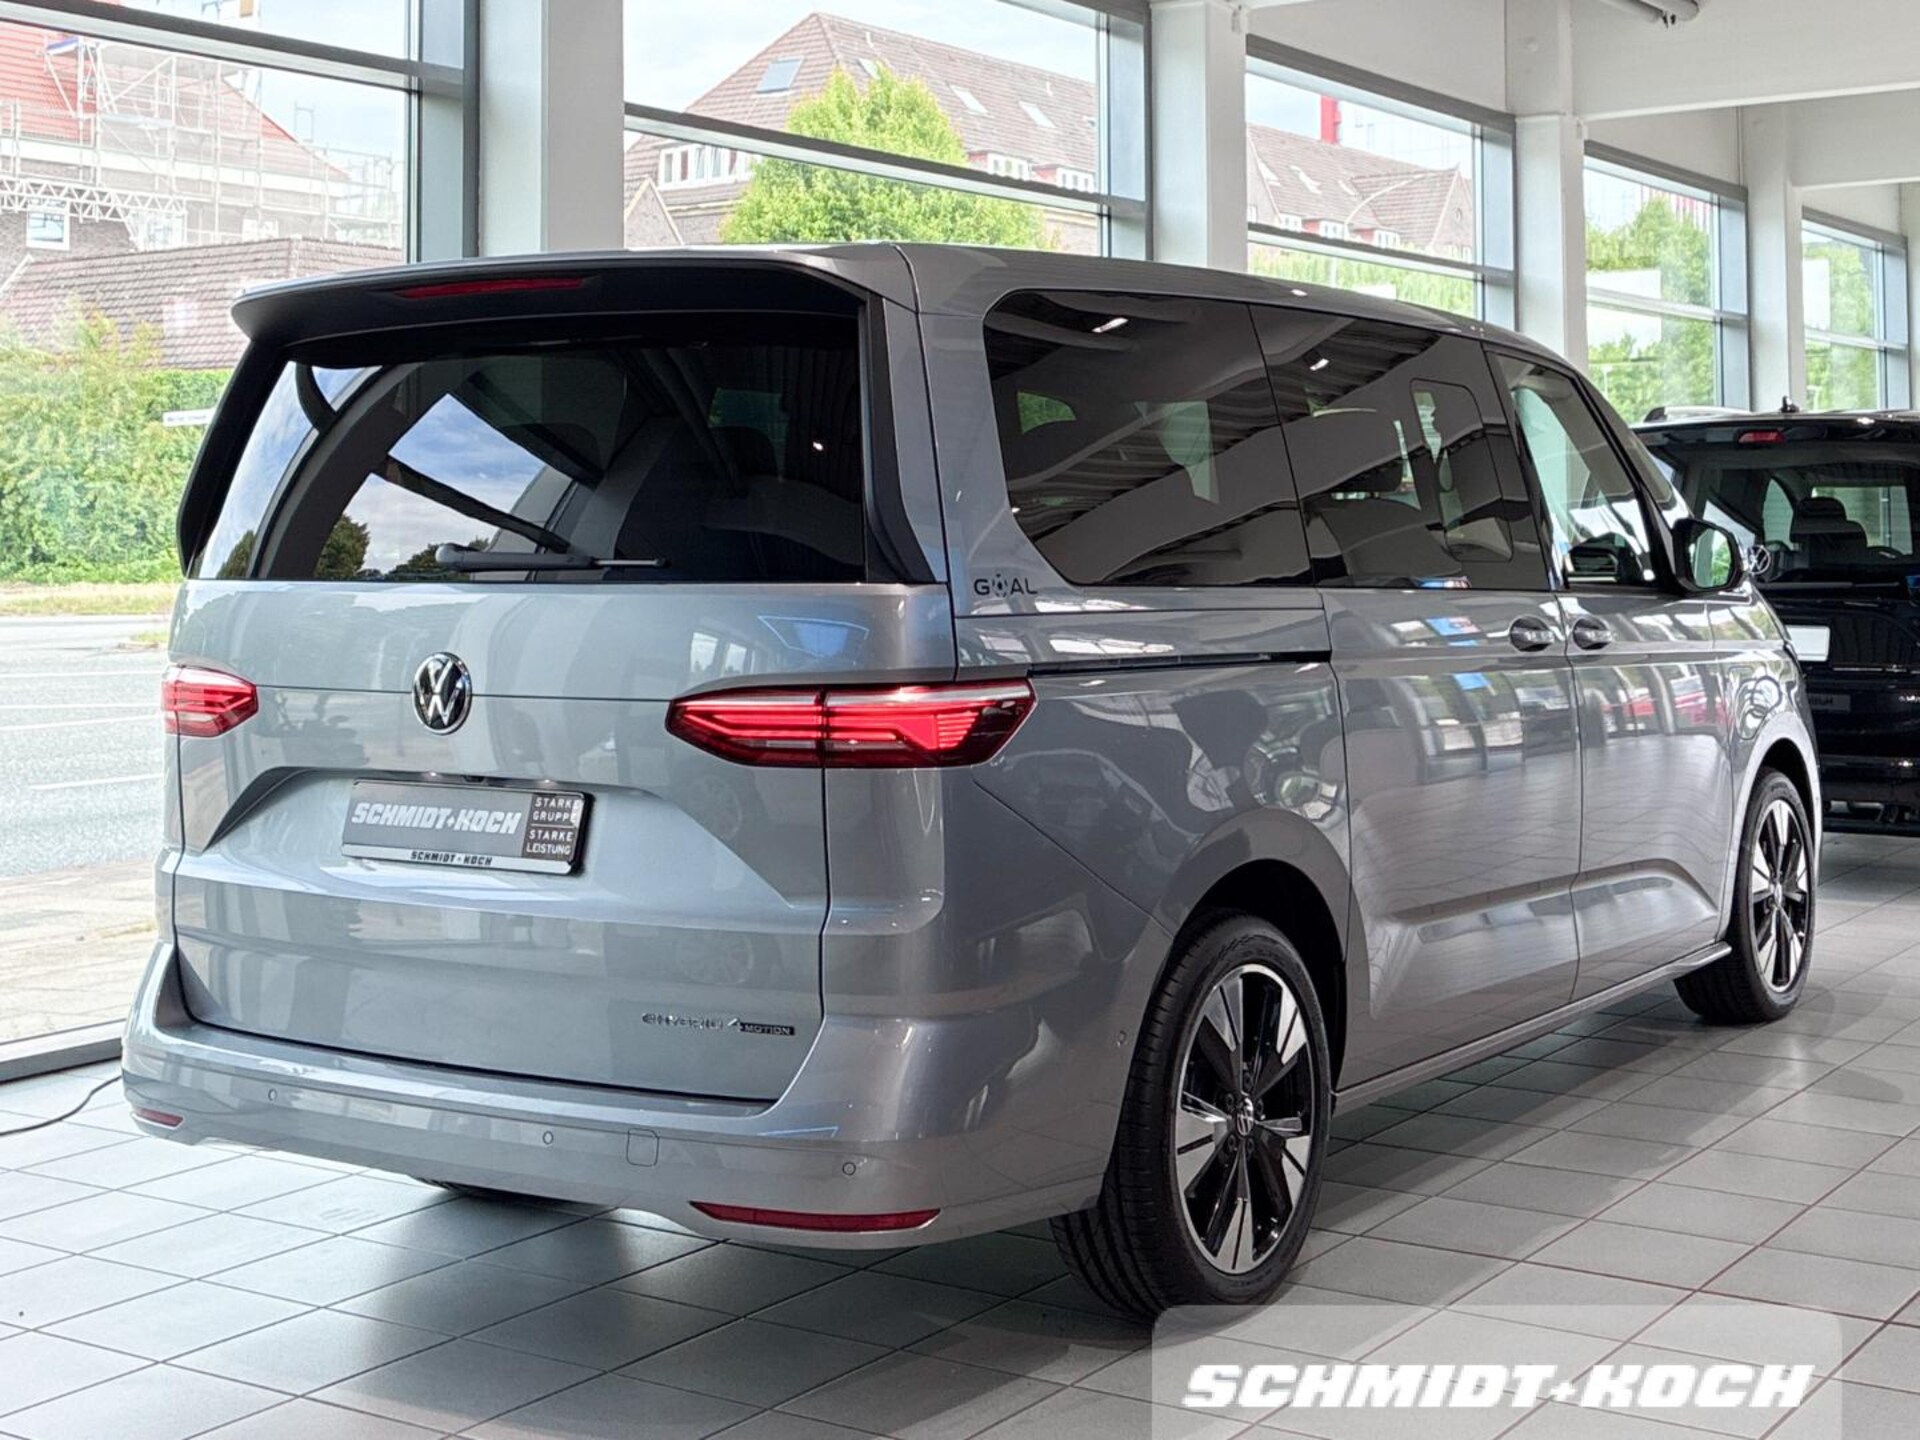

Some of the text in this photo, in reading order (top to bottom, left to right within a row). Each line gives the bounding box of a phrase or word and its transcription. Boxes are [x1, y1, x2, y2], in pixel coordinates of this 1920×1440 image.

[974, 574, 1038, 597] GOAL
[535, 797, 582, 810] STARKE
[532, 811, 578, 824] GRUPPE
[529, 829, 574, 842] STARKE
[526, 842, 571, 856] LEISTUNG
